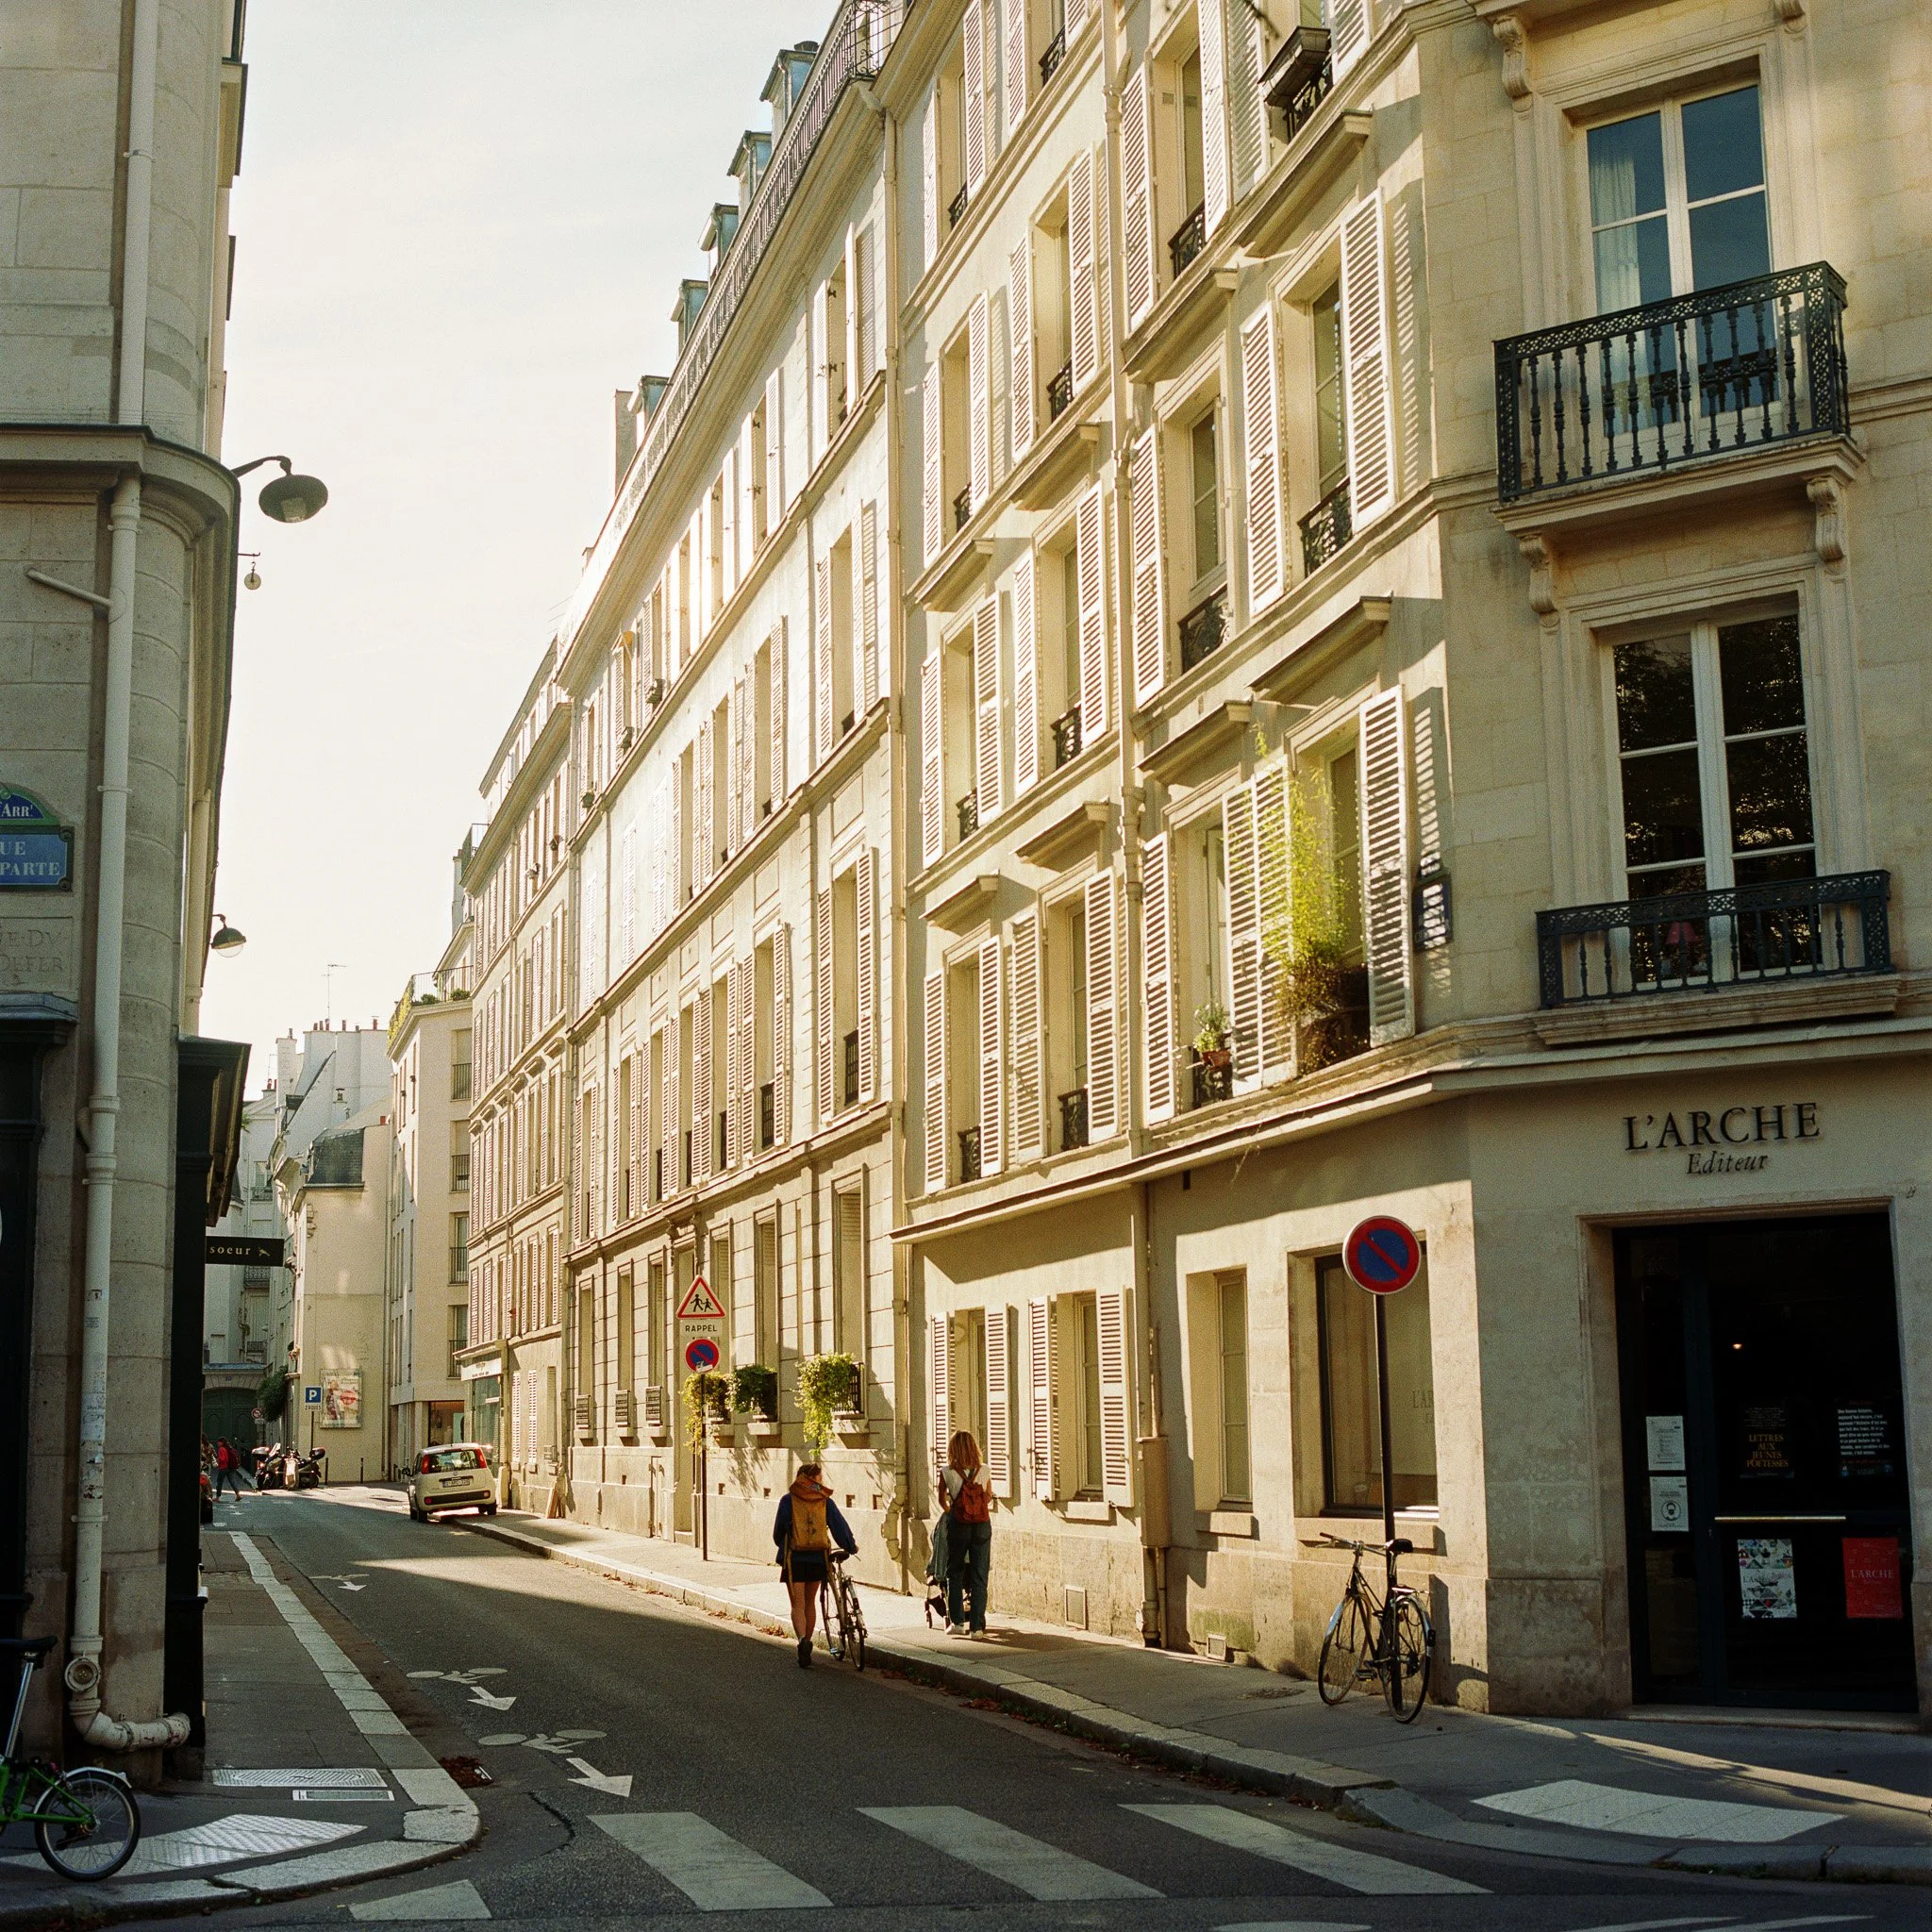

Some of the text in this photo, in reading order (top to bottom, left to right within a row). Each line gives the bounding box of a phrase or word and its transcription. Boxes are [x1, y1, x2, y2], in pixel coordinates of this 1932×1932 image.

[1623, 1102, 1821, 1151] L'ARCHE
[1686, 1150, 1769, 1175] Editeur
[209, 1246, 251, 1256] soeur
[308, 1390, 318, 1401] P
